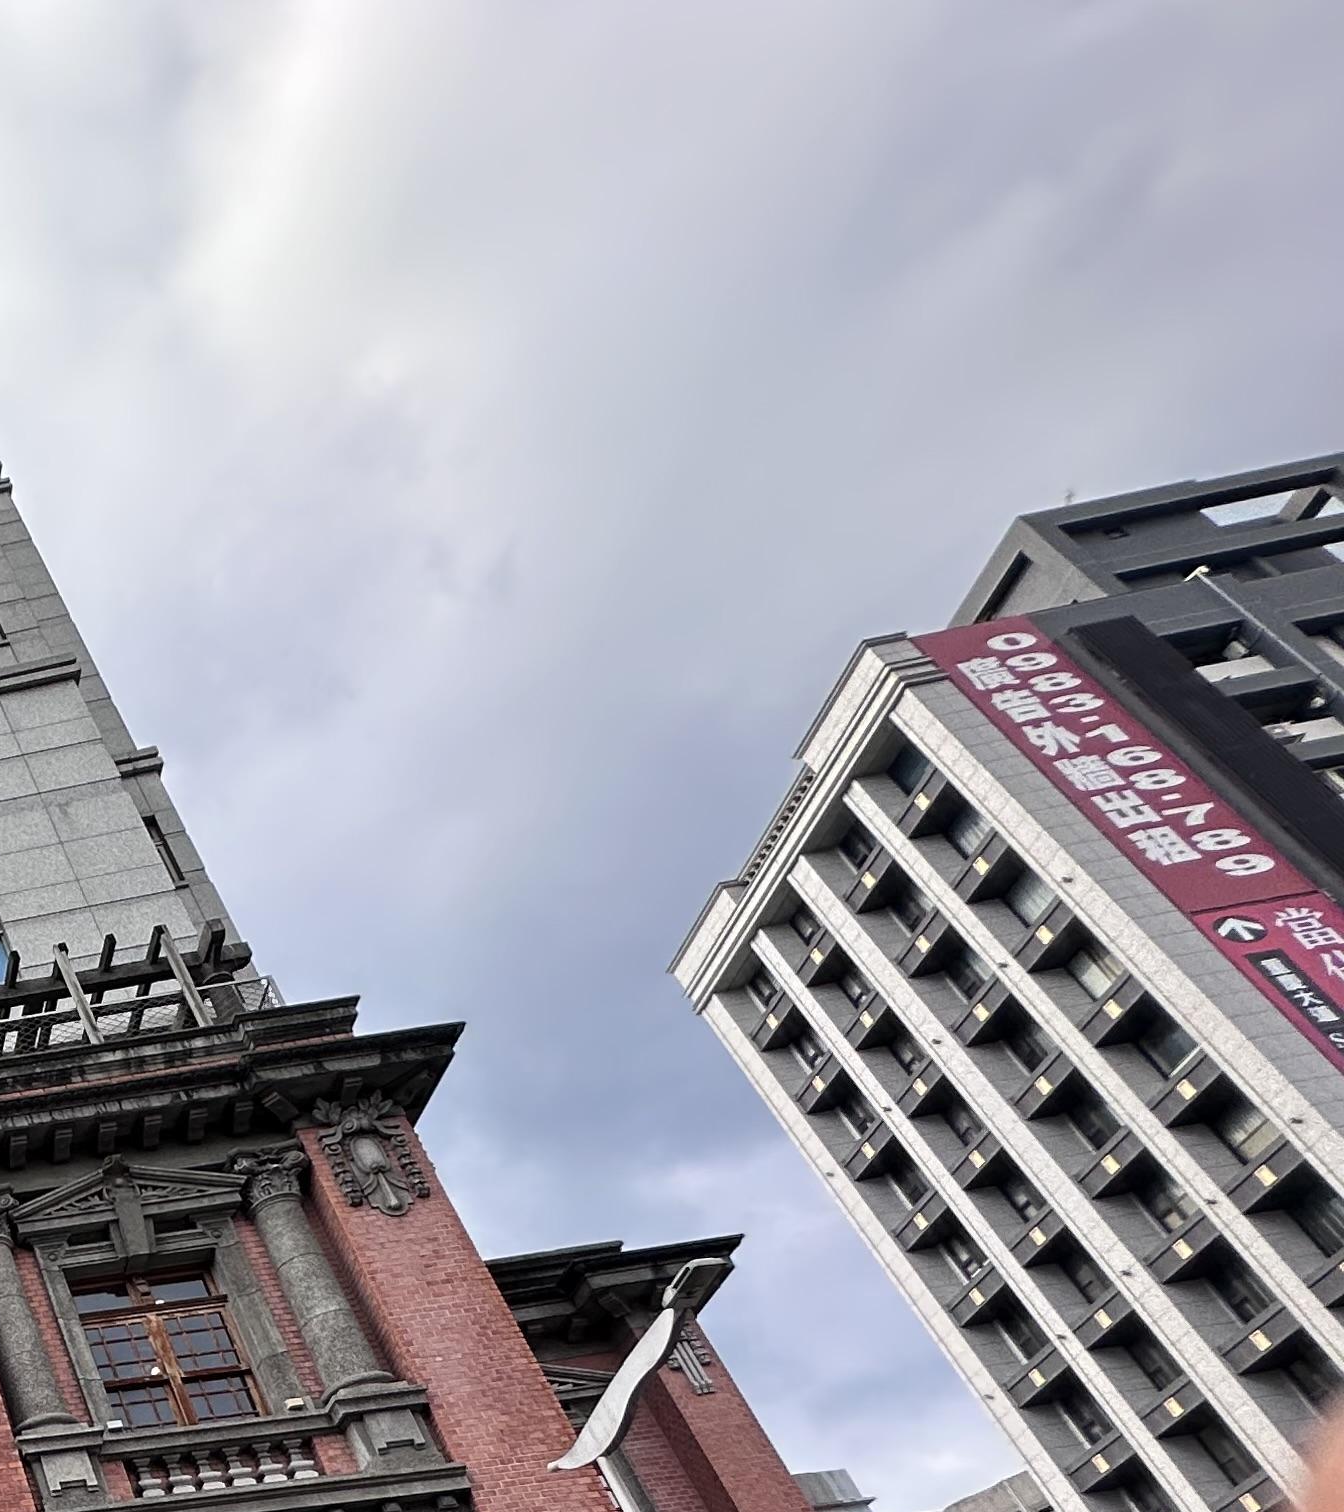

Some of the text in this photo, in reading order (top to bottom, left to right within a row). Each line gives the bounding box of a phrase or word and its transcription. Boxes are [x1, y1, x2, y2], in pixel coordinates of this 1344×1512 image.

[956, 656, 1203, 866] 廣告外牆出租
[986, 632, 1275, 876] 0983-168-789
